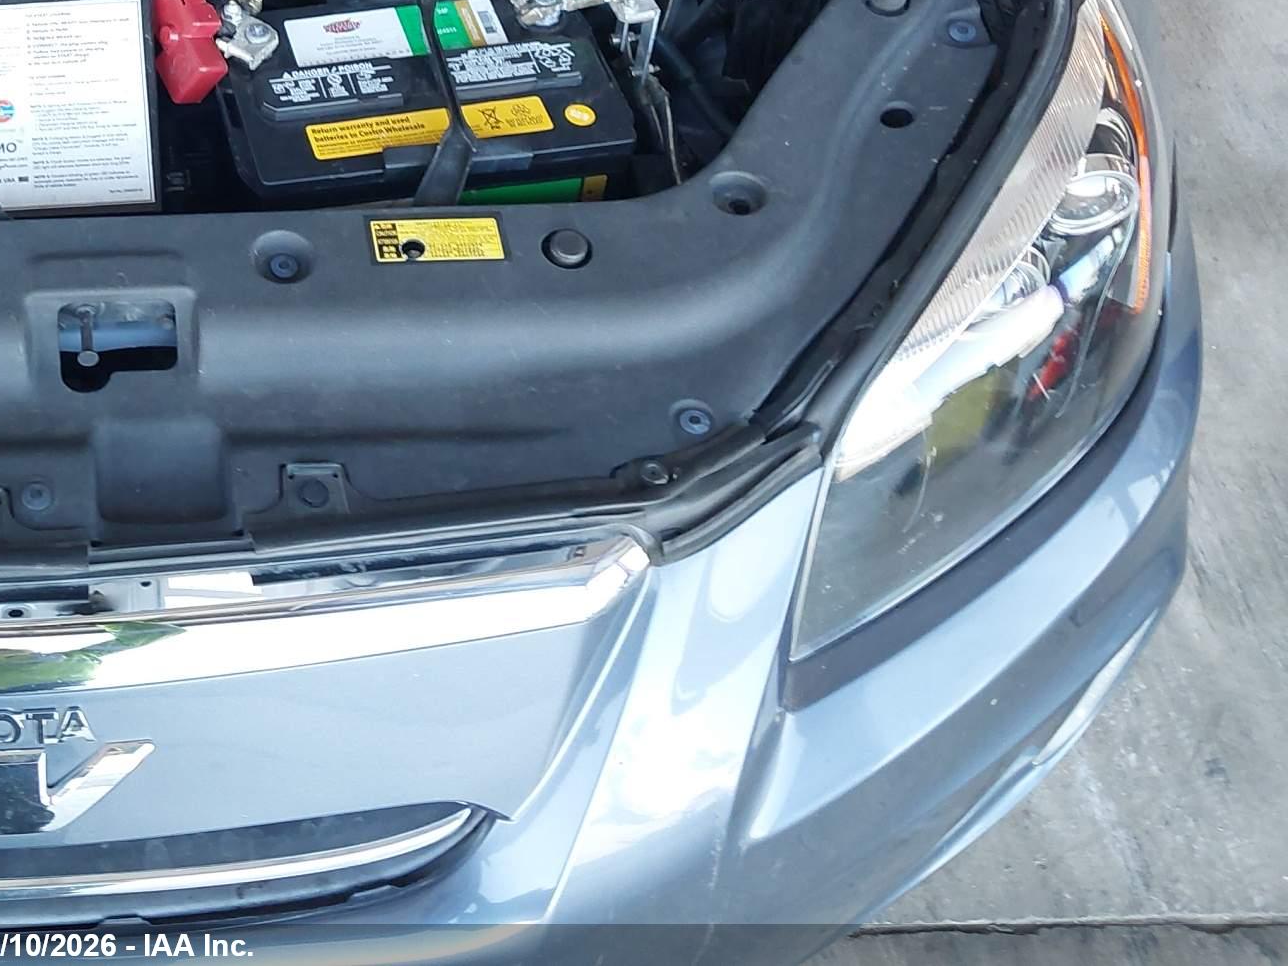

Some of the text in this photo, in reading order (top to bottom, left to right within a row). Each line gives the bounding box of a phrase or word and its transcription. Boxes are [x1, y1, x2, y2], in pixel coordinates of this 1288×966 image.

[311, 116, 411, 134] Return warranty and used
[314, 133, 349, 142] batteries
[385, 122, 425, 134] Wholesale
